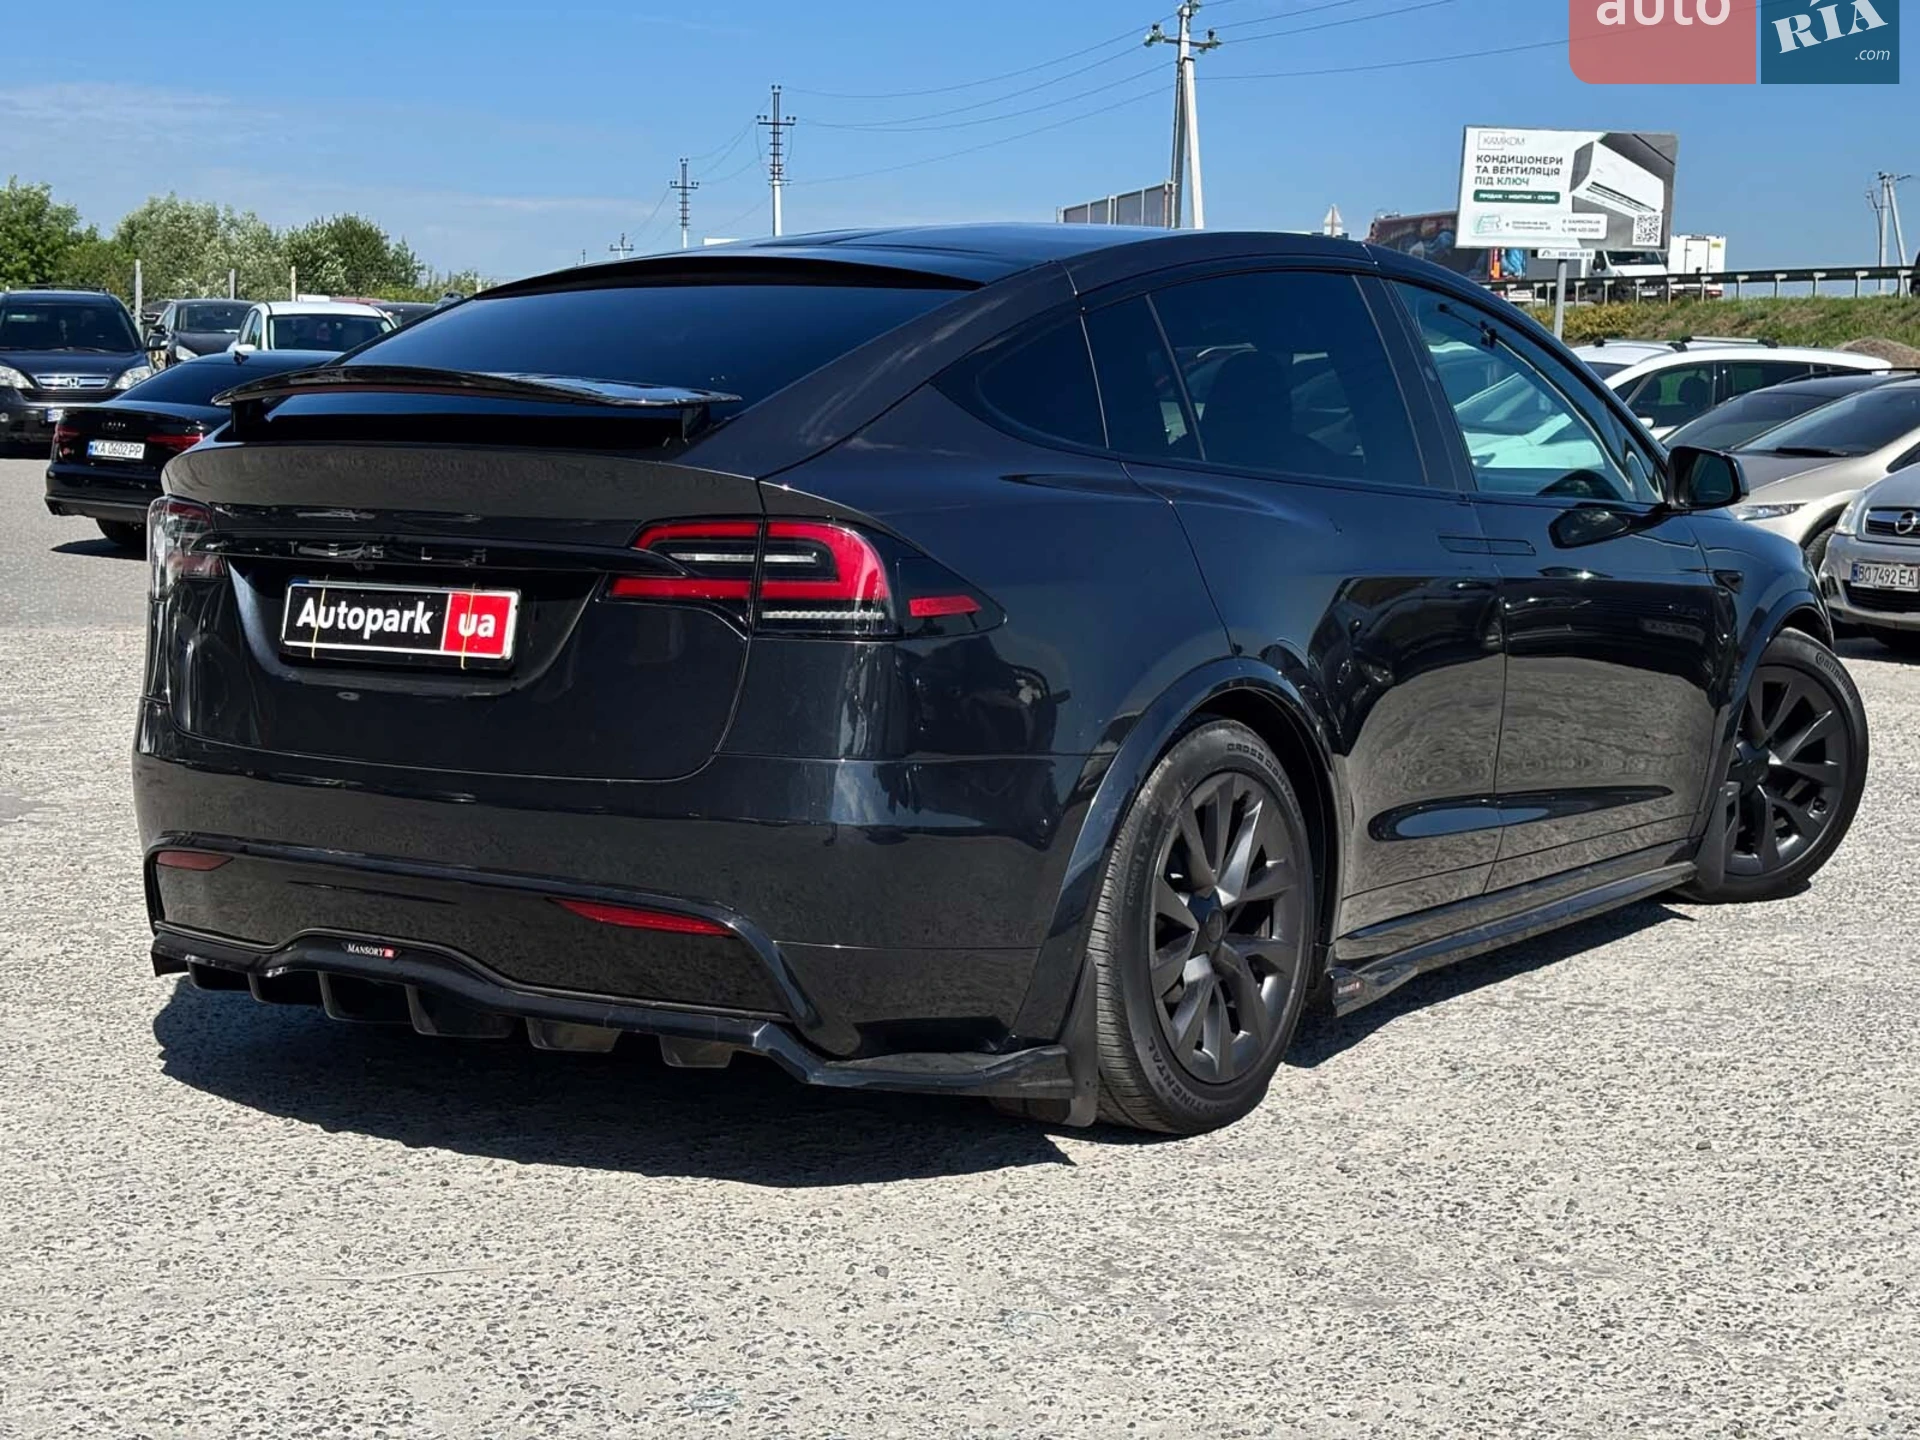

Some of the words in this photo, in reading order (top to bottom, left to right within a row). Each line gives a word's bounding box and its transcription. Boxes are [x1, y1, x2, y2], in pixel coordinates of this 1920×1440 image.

[1476, 154, 1563, 165] КОНДИЦІОНЕРИ
[1475, 165, 1489, 174] ТА
[1492, 165, 1560, 177] ВЕНТИЛЯЦІЯ
[1474, 176, 1494, 186] ПІД
[1497, 177, 1529, 186] КЛЮЧ
[95, 441, 106, 454] KA
[128, 444, 143, 456] PP
[1872, 567, 1897, 584] 7492
[1899, 569, 1915, 586] EA
[296, 597, 434, 640] Autopark
[457, 612, 496, 638] ua
[347, 943, 385, 957] MANSORY
